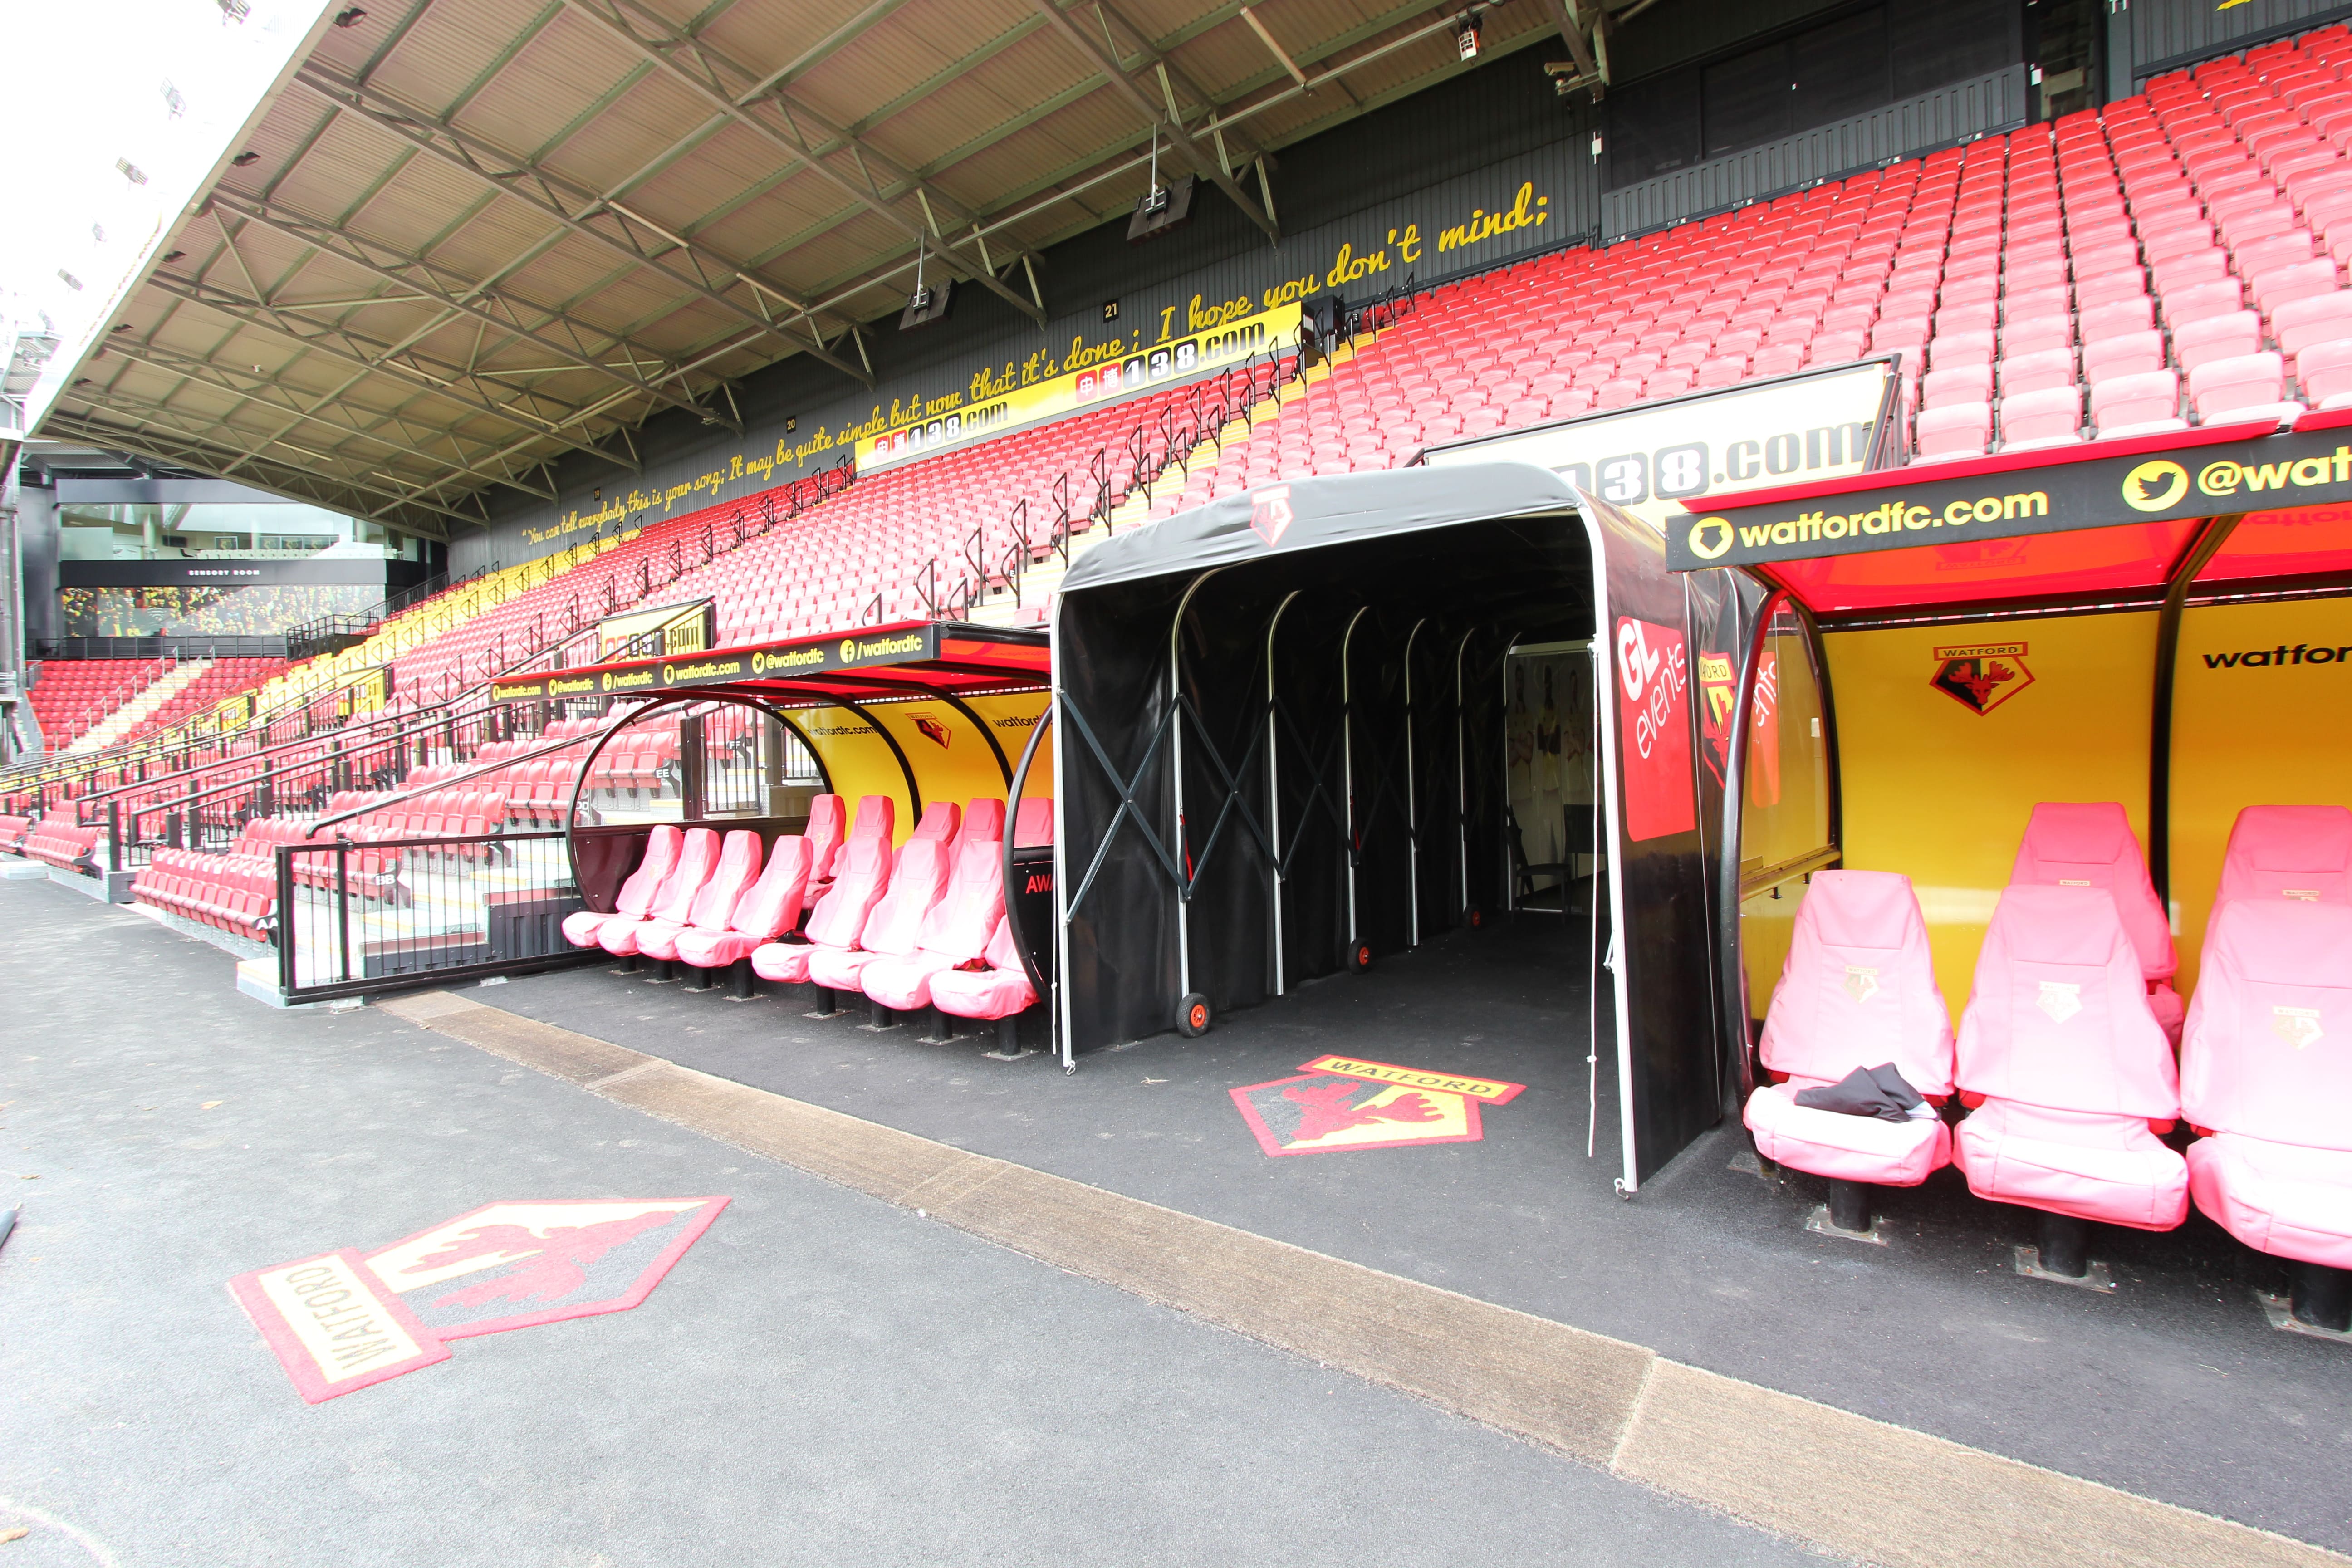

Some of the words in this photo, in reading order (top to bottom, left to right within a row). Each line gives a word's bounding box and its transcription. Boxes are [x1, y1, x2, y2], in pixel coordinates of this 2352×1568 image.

[1104, 303, 1117, 318] 21
[546, 528, 559, 539] can
[560, 510, 577, 533] tell
[578, 496, 626, 533] everybody
[627, 489, 650, 513] this
[652, 489, 662, 505] is
[666, 481, 692, 511] your
[728, 454, 743, 481] It
[746, 455, 774, 481] may
[777, 439, 794, 465] be
[796, 426, 834, 468] quite
[836, 405, 887, 446] simple
[890, 394, 921, 427] but
[926, 392, 962, 416] now
[970, 367, 1016, 402] that
[1022, 348, 1058, 385] it's
[1156, 306, 1176, 343] I
[1189, 294, 1253, 332] hope
[1264, 274, 1321, 310] you
[1327, 224, 1421, 288] don't
[1438, 181, 1548, 252] mind;
[1124, 322, 1265, 387] 138.com
[787, 419, 795, 430] 20
[909, 401, 1008, 452] 138.com
[595, 490, 600, 498] 19
[1740, 491, 2048, 547] watfordfc.com
[856, 634, 923, 660] /watfordfc
[1943, 646, 2018, 657] WATFORD
[766, 647, 824, 669] @watfordfc
[1618, 617, 1660, 701] GL
[613, 671, 653, 689] /watfordfc
[676, 662, 740, 680] watfordfc.com
[500, 685, 541, 698] watfordfc.com
[557, 678, 593, 693] @watfordfc
[1637, 643, 1686, 759] events
[807, 726, 878, 736] watfordfc.com
[656, 769, 670, 778] EE
[375, 874, 395, 886] BB
[1331, 1060, 1492, 1095] WATFORD
[285, 1266, 397, 1370] WATFORD
